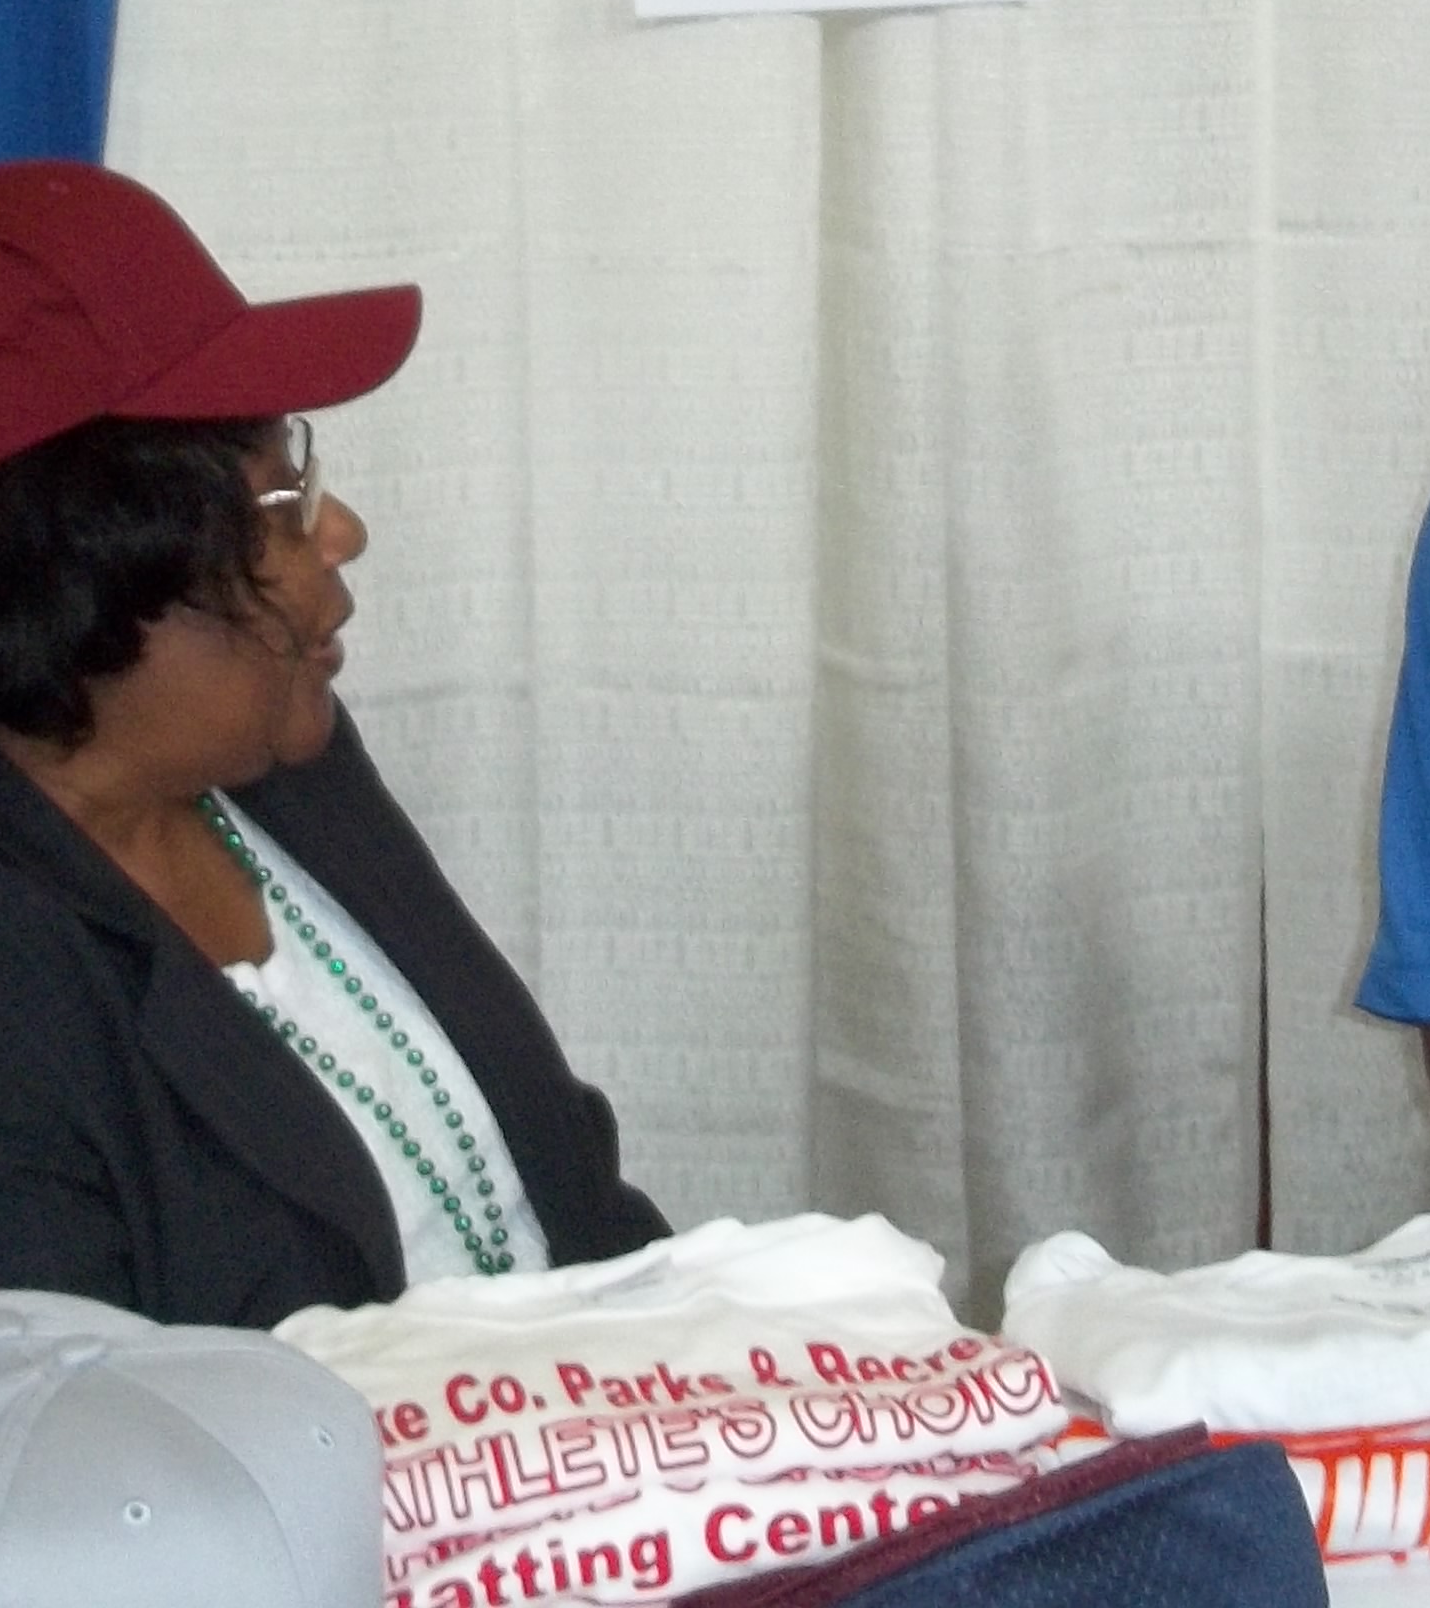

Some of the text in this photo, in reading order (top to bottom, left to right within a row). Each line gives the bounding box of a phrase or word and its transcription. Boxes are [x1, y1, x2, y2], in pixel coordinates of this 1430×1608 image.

[445, 1373, 547, 1424] Co.
[556, 1360, 736, 1407] Parks
[749, 1346, 801, 1388] &
[806, 1337, 983, 1385] Recre
[789, 1350, 1061, 1448] CHOIC
[384, 1530, 672, 1608] atting
[705, 1490, 957, 1562] Cente
